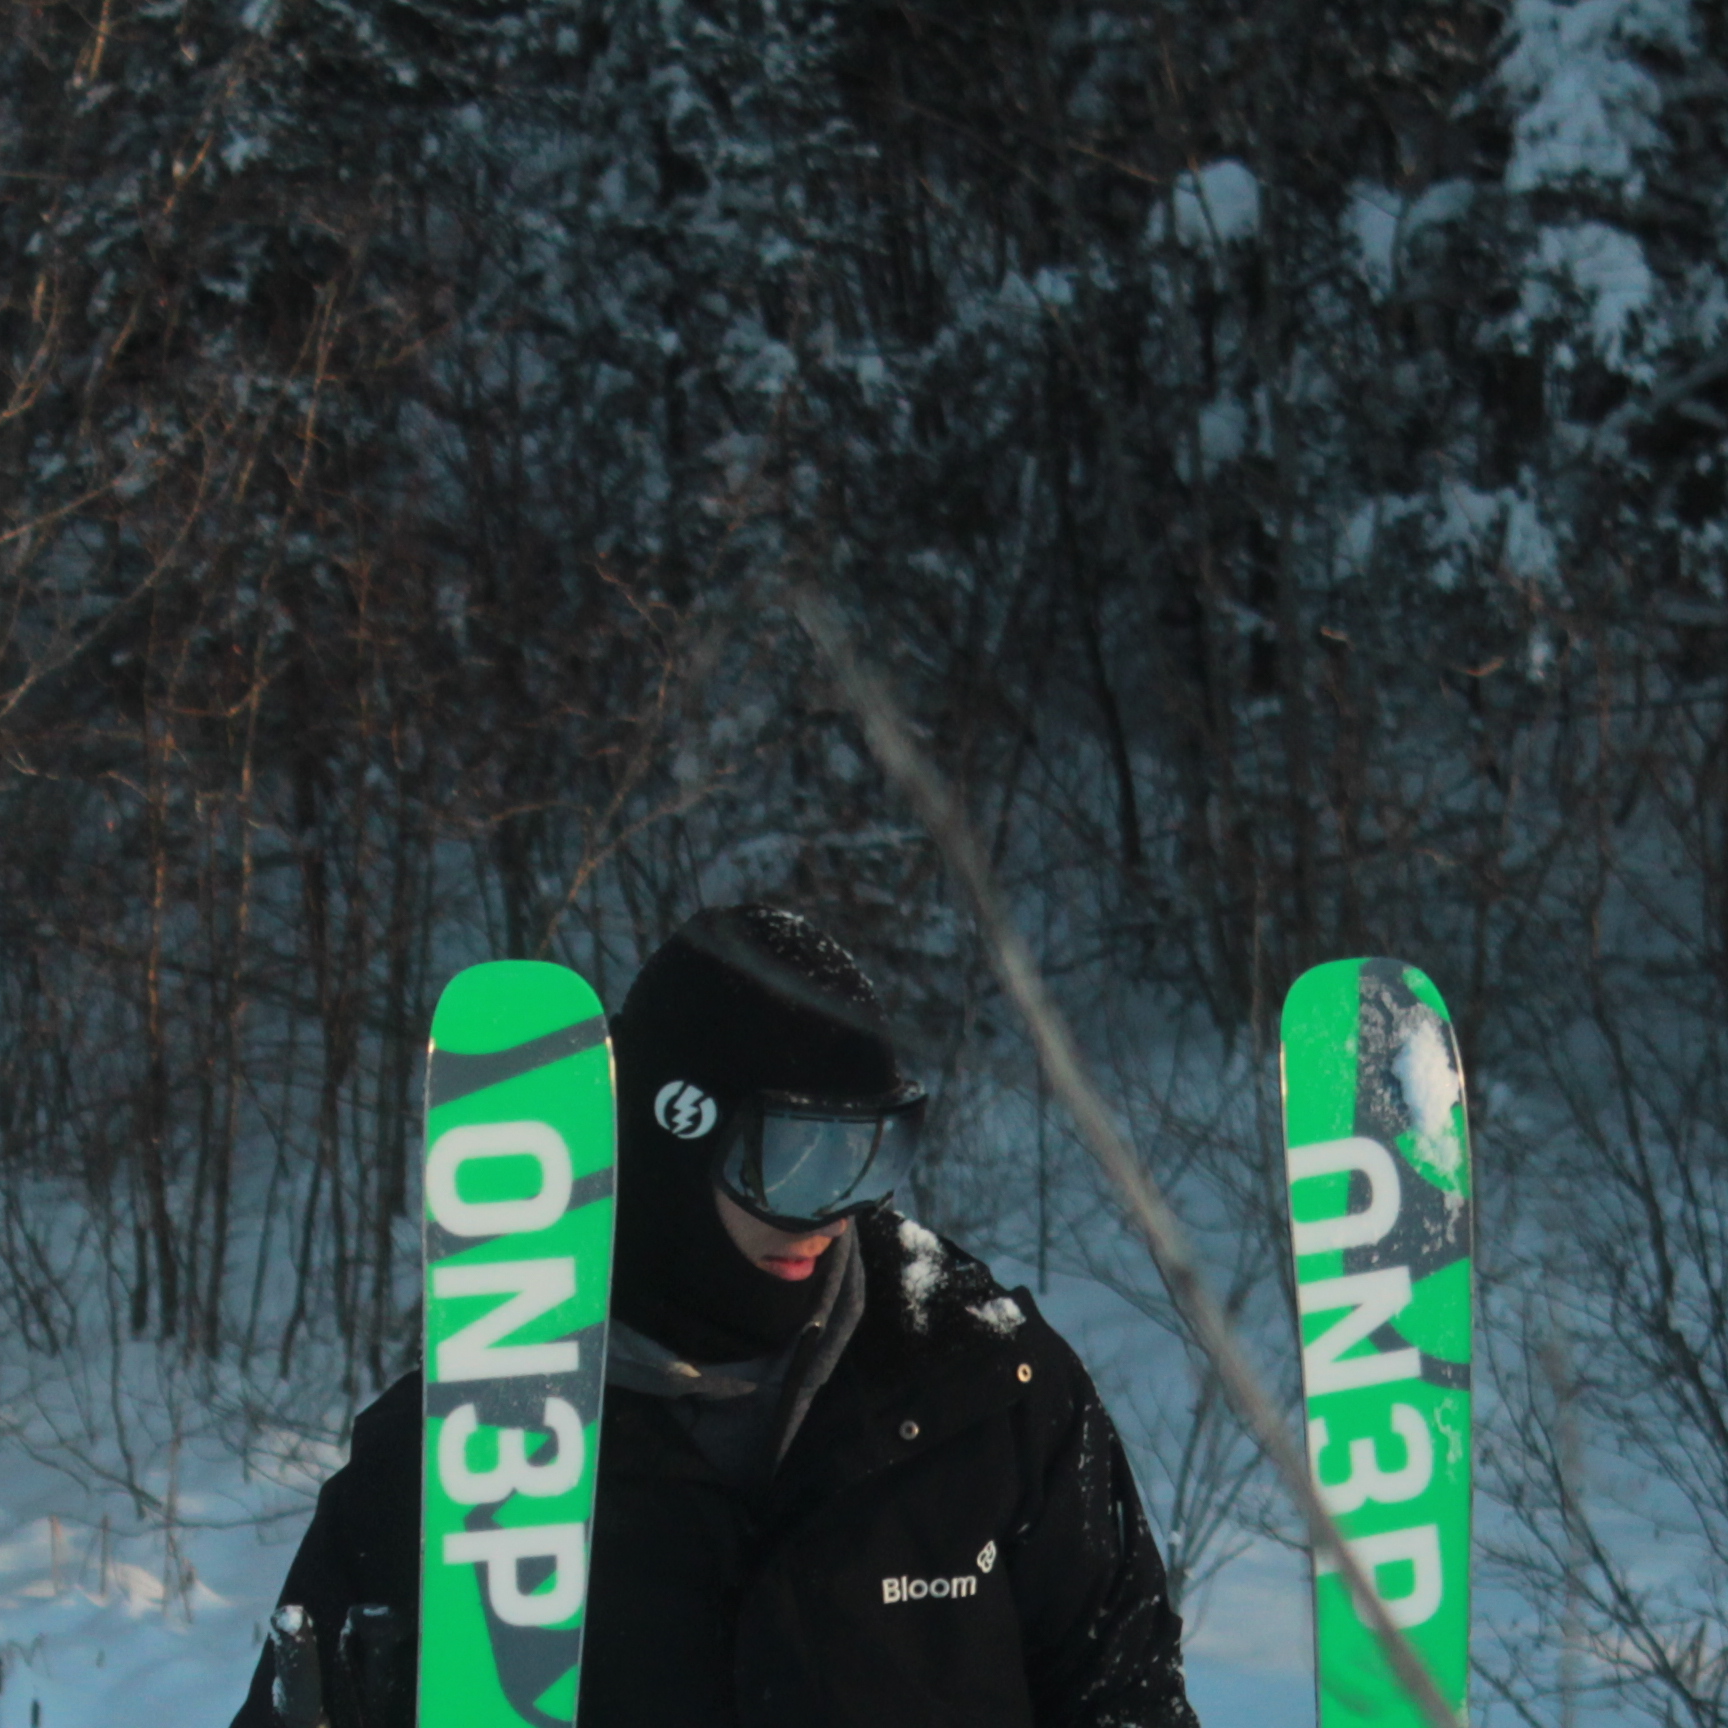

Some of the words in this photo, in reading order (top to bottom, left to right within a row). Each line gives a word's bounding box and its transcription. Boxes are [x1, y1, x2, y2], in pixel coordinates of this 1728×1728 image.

[425, 1121, 585, 1628] ON3P
[882, 1575, 977, 1604] Bloom
[1286, 1136, 1444, 1630] ON3P
